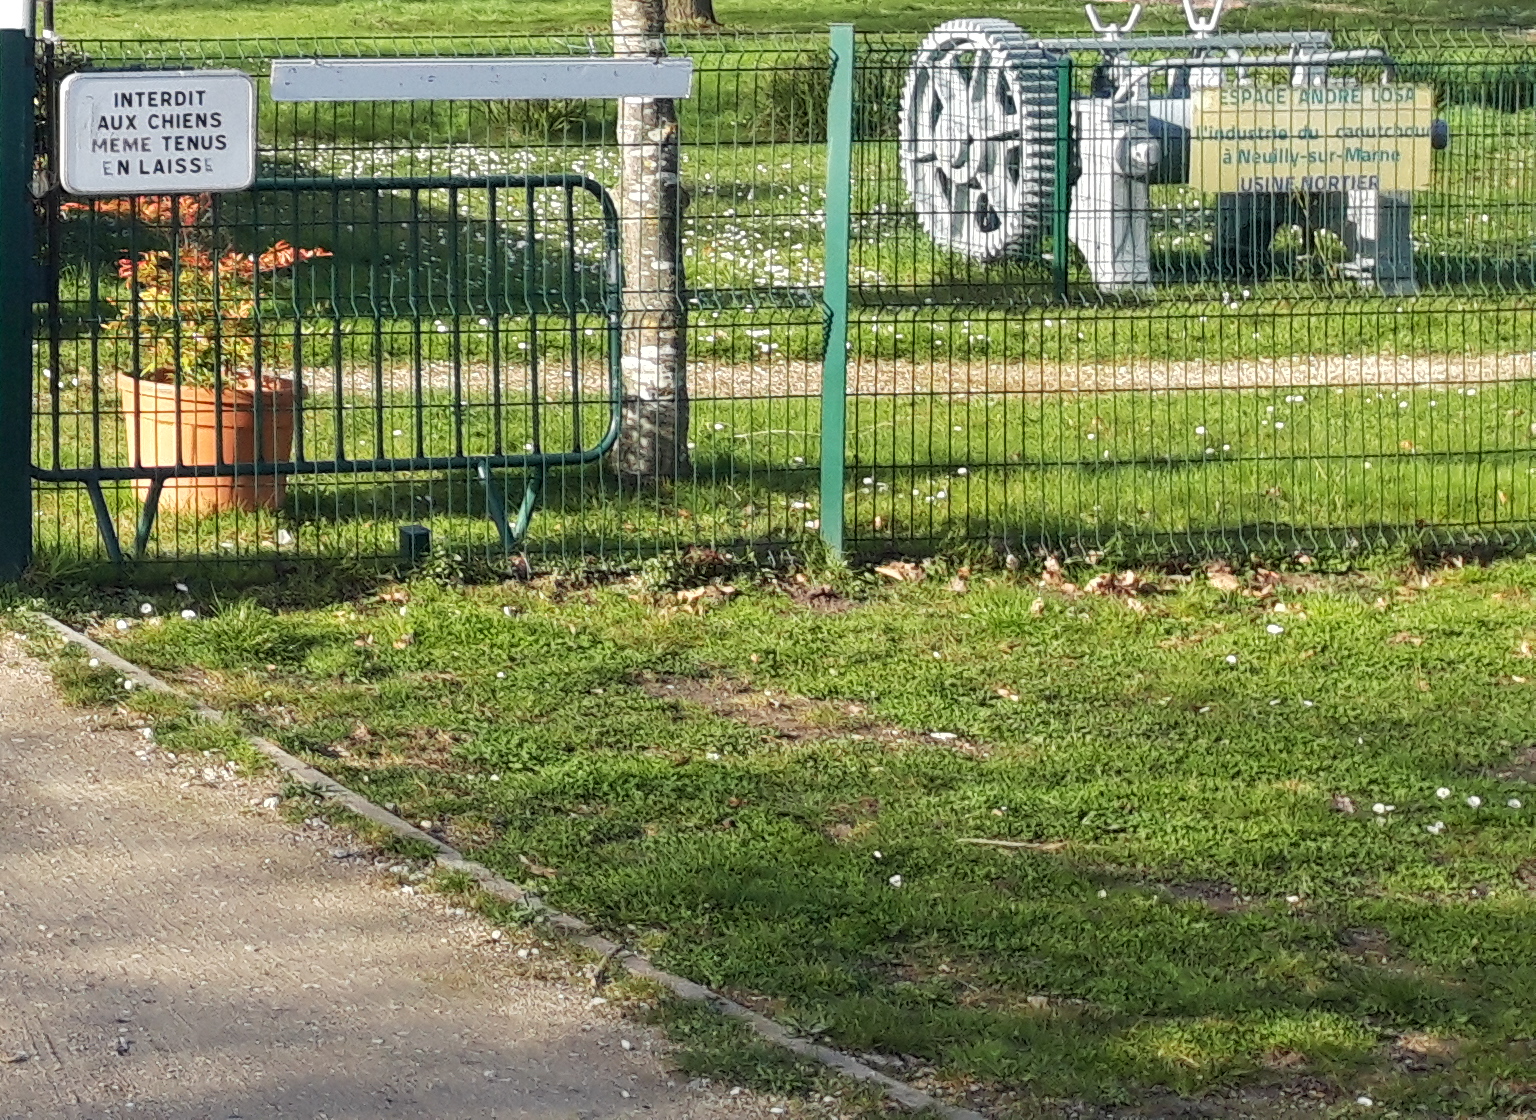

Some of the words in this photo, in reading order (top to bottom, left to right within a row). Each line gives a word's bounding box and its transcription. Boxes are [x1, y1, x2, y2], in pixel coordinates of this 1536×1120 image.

[114, 90, 206, 108] INTERDIT
[1219, 87, 1286, 105] ESPACE
[98, 114, 137, 131] AUX
[148, 112, 222, 129] CHIENS
[1299, 124, 1319, 140] du
[162, 135, 227, 152] TENUS
[1222, 148, 1232, 164] à
[1237, 146, 1401, 167] Neuilly-sur-Marne
[102, 159, 130, 176] EN
[140, 157, 214, 175] LAISSE
[1241, 176, 1295, 192] USINE
[1301, 175, 1378, 191] NORTIER
